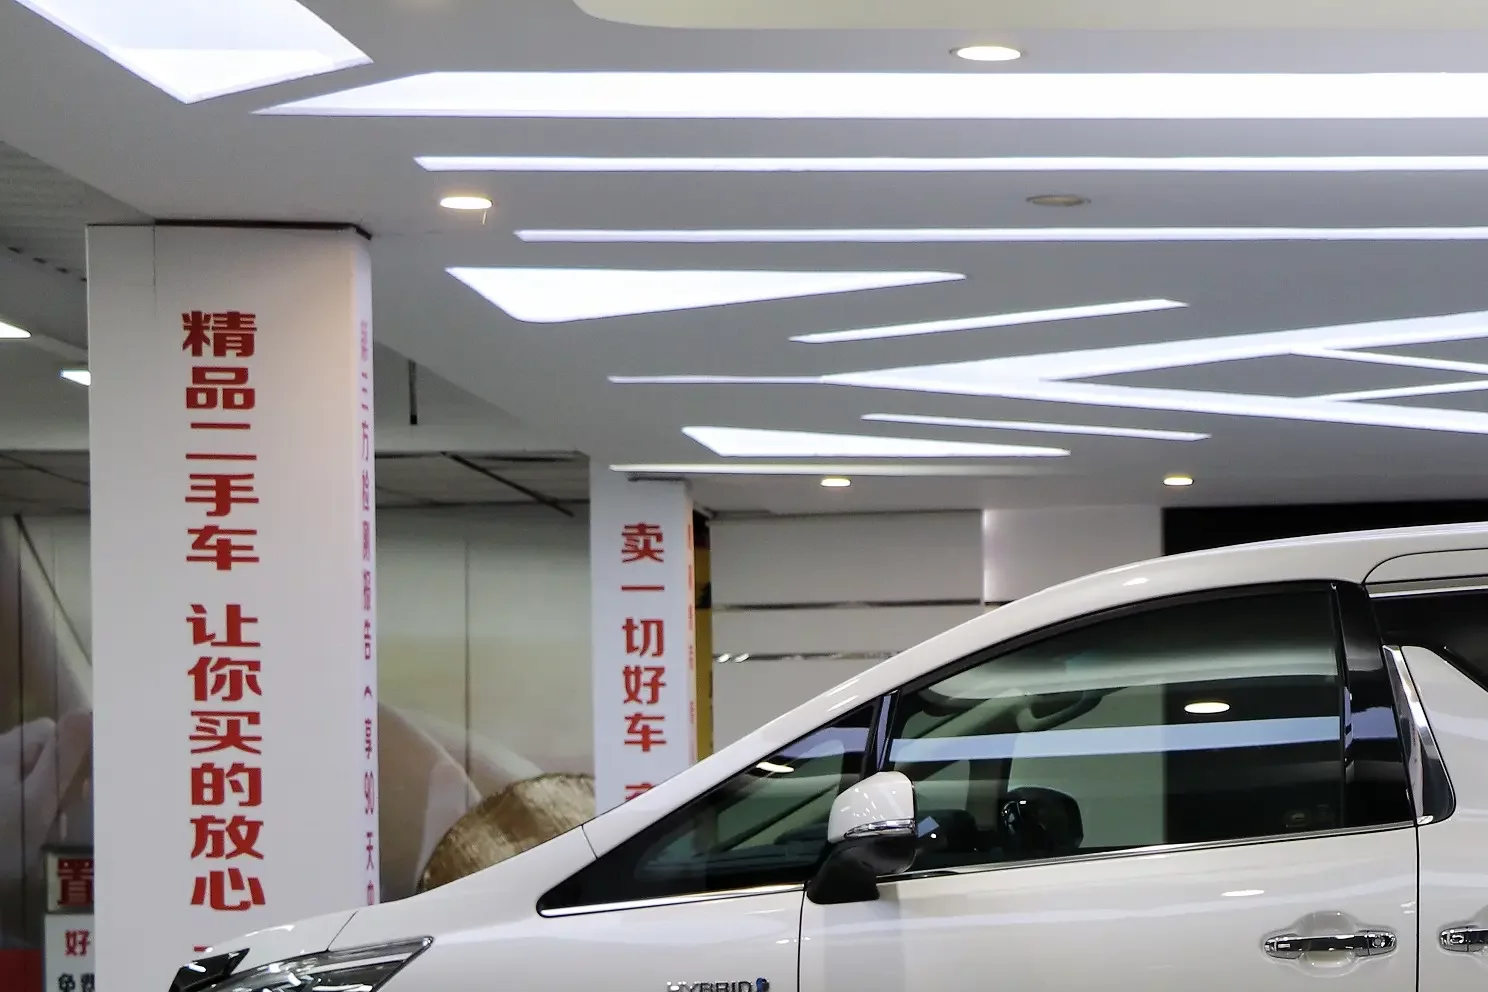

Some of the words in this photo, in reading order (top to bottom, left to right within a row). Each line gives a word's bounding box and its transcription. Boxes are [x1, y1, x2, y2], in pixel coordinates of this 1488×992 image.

[182, 311, 260, 571] 精品二手车
[186, 604, 265, 911] 让你买的放心
[621, 523, 667, 752] 卖一切好车
[64, 929, 91, 957] 好
